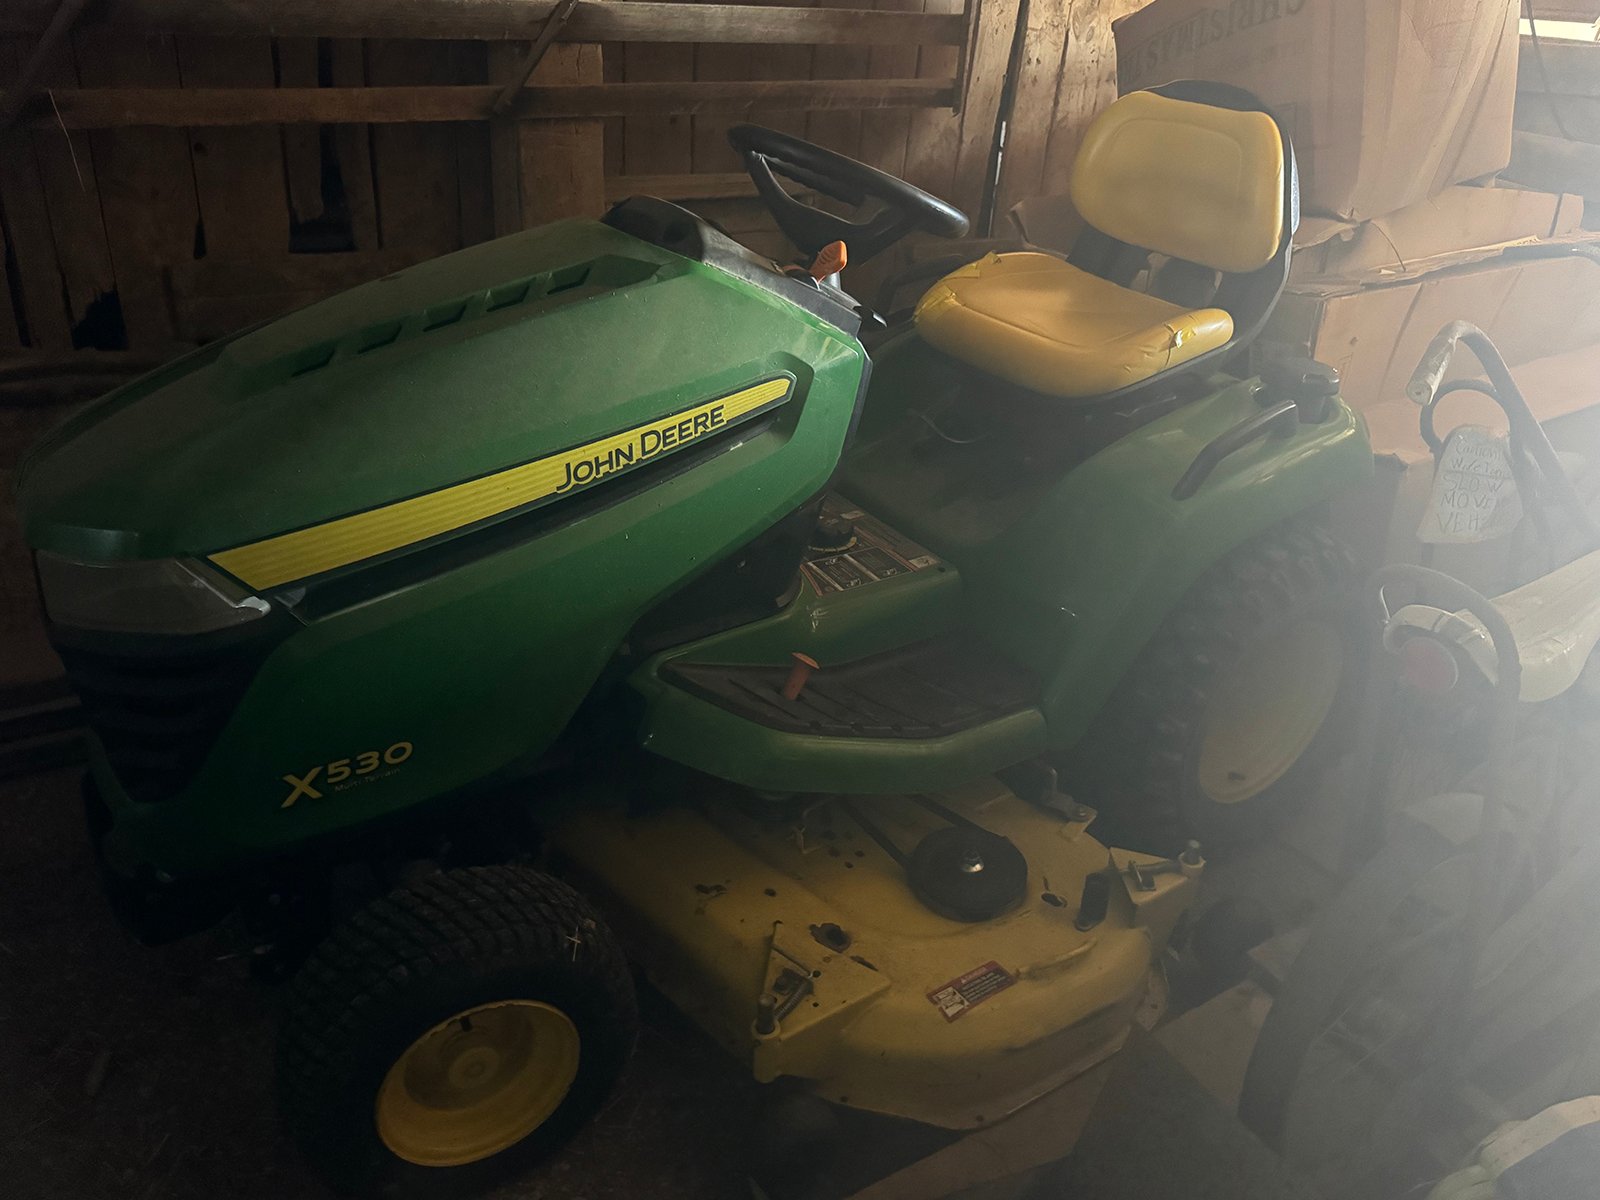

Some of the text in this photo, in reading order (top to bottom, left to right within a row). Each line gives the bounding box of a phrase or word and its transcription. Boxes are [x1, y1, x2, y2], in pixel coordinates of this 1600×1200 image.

[556, 404, 727, 492] JOHN DEERE
[1441, 473, 1504, 493] SLOW
[280, 740, 413, 809] X530
